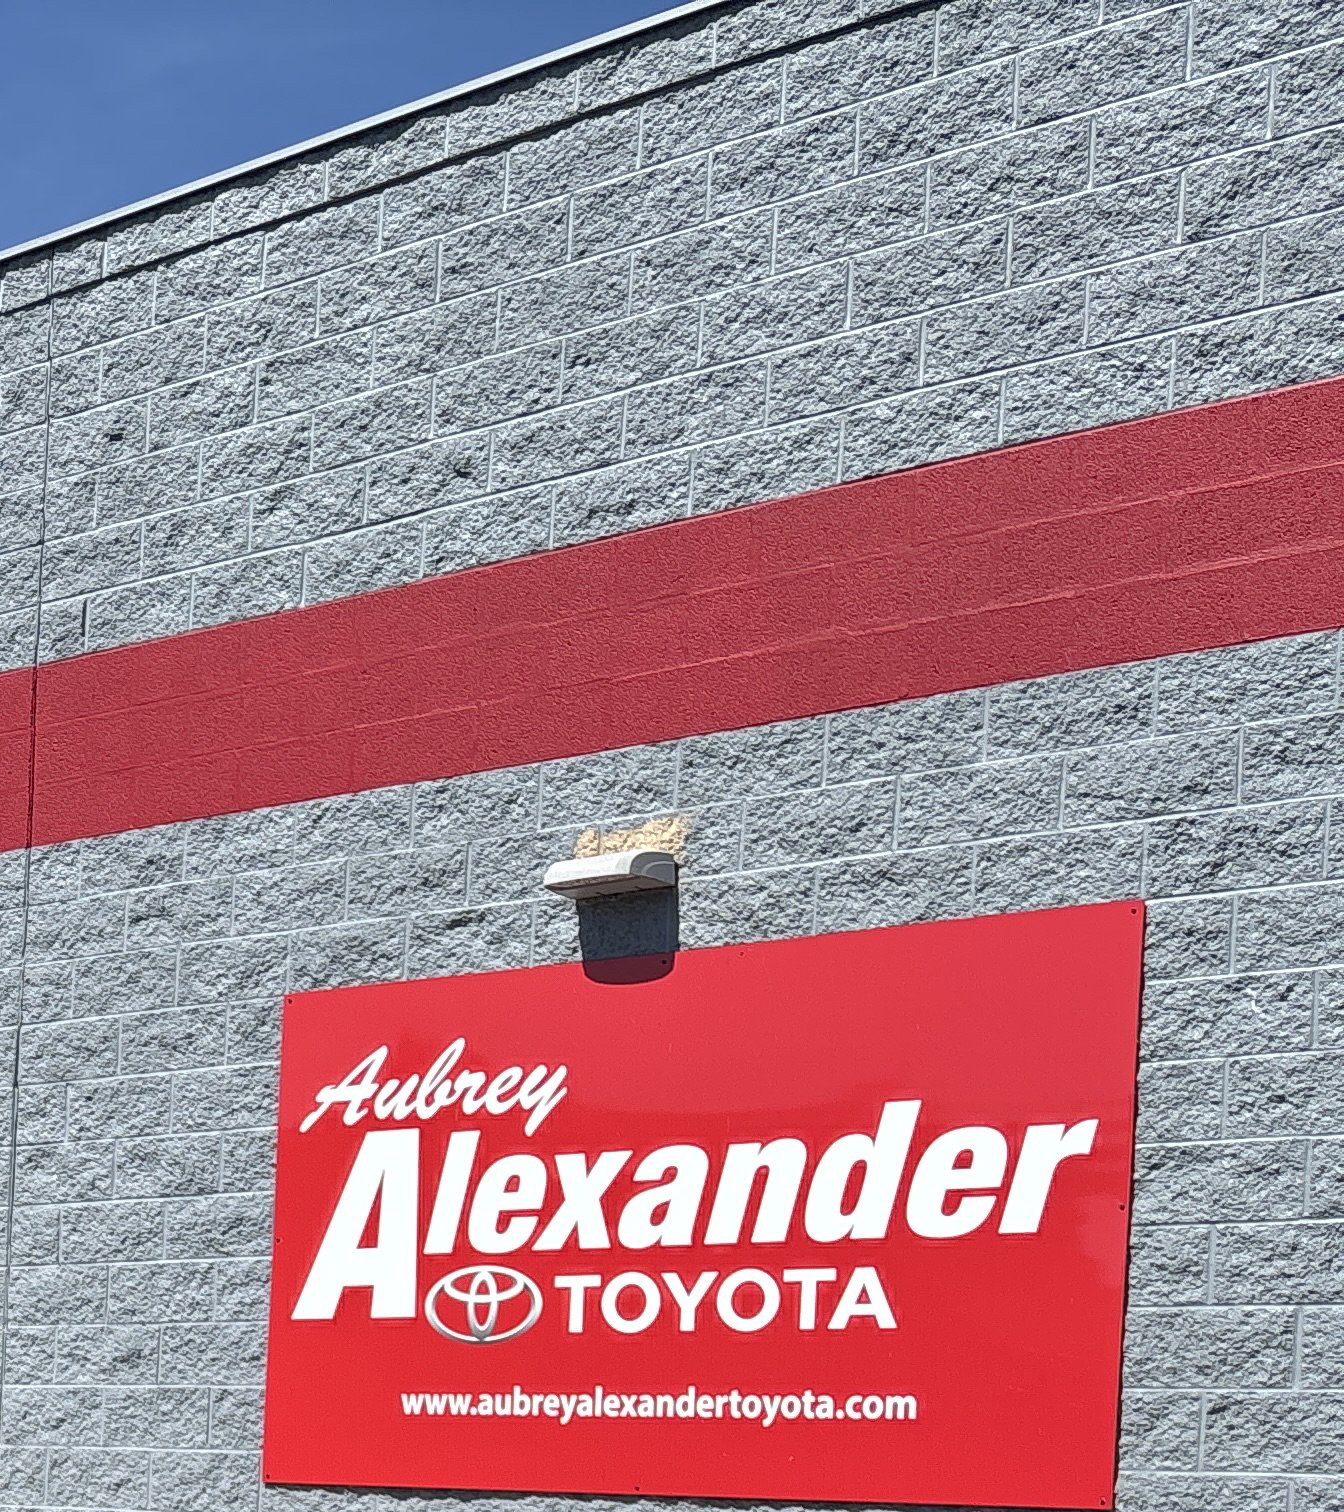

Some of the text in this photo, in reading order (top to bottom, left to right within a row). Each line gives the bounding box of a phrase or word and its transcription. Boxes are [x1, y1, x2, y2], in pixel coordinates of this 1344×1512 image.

[299, 1037, 568, 1137] Aubrey
[291, 1099, 1100, 1321] Alexander
[554, 1265, 898, 1334] TOYOTA
[400, 1385, 918, 1428] www.aubreyalexandertoyota.com
